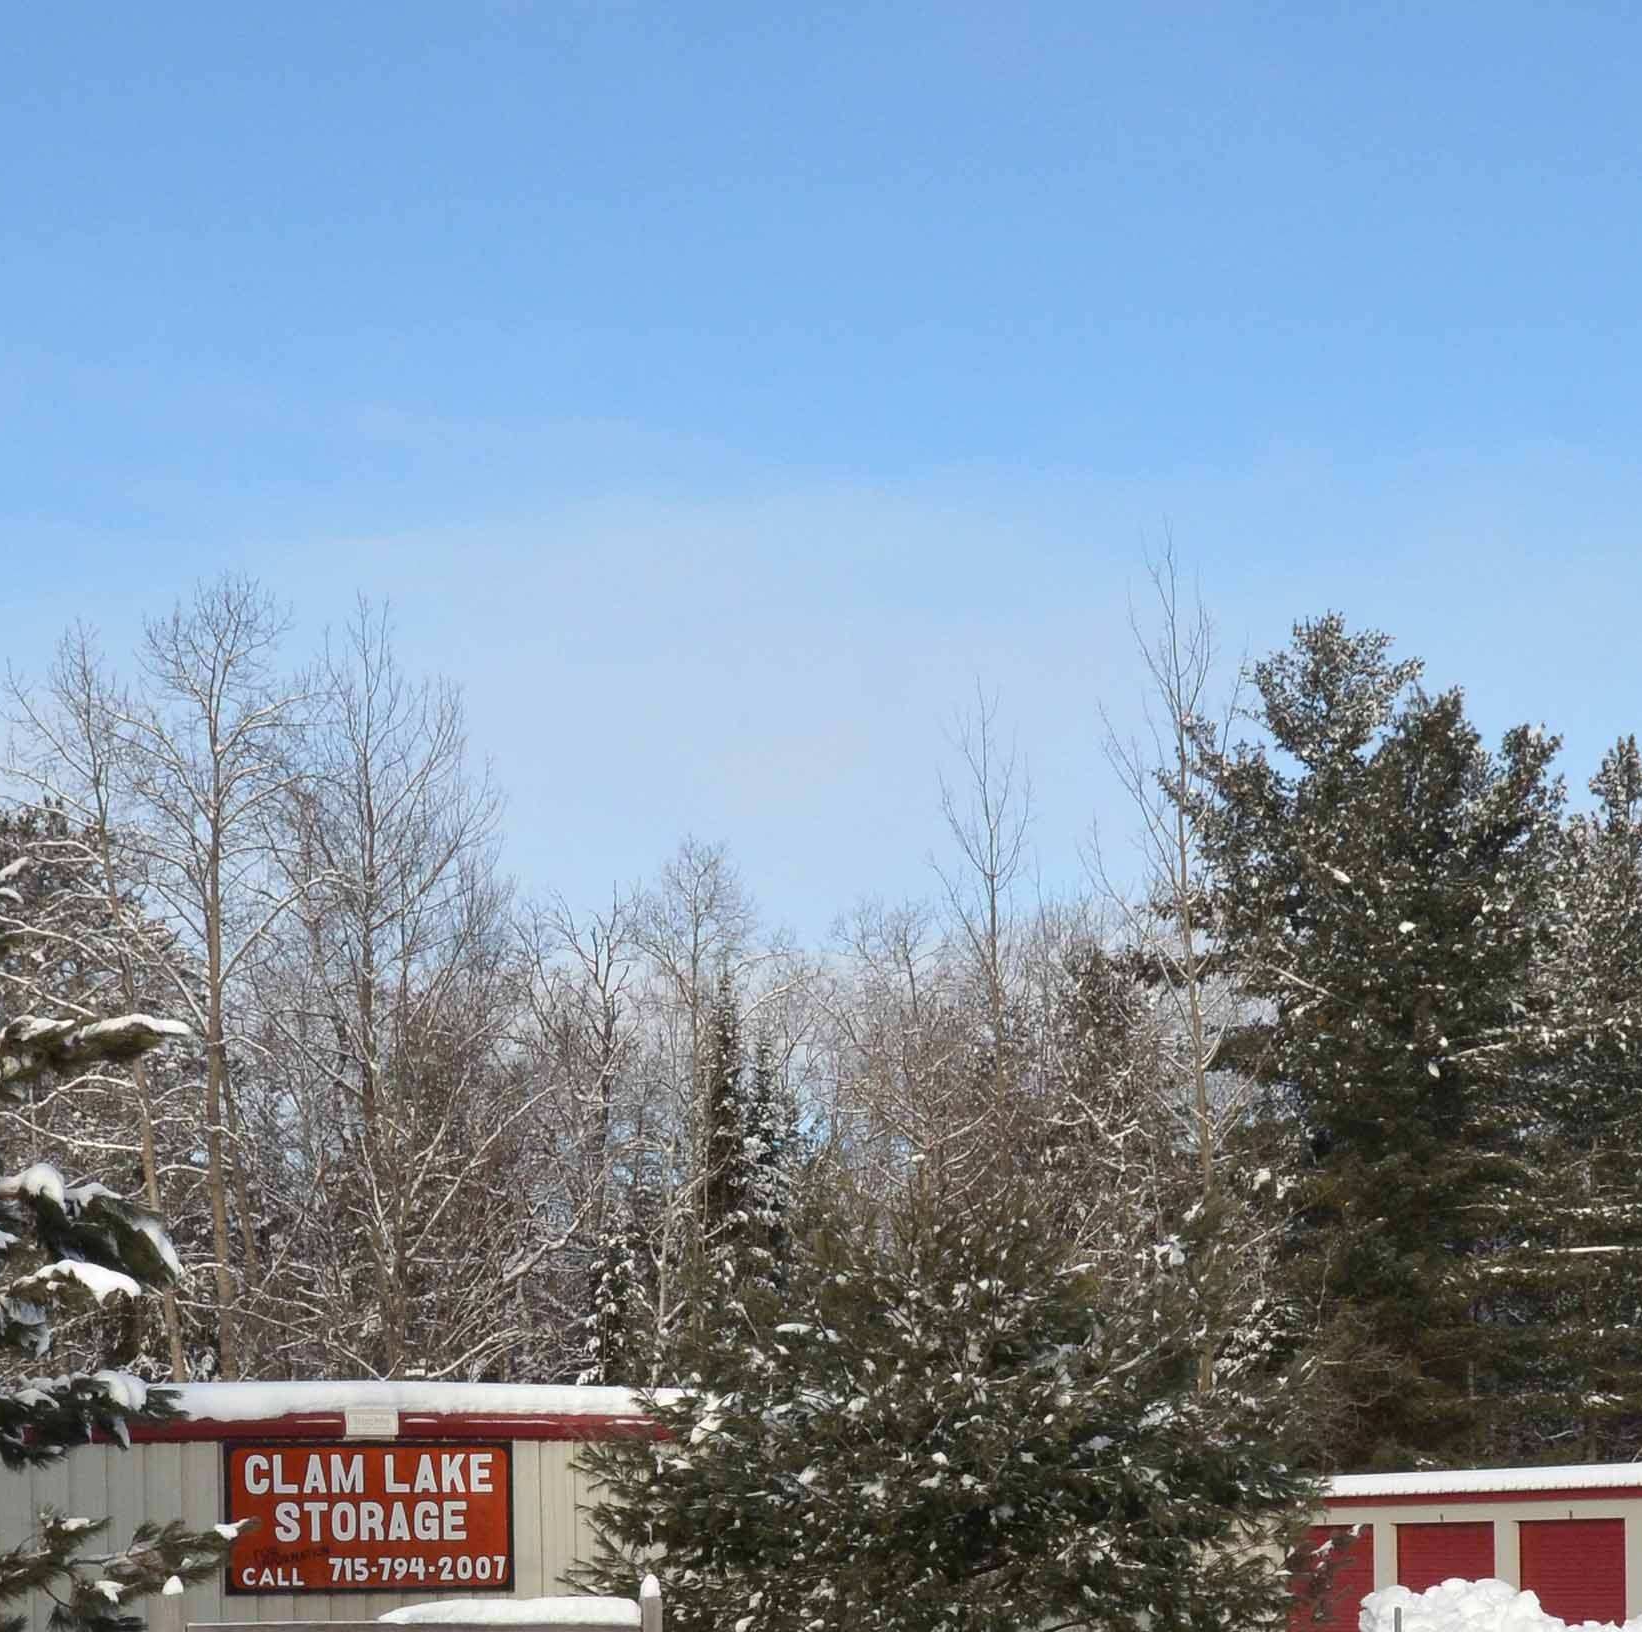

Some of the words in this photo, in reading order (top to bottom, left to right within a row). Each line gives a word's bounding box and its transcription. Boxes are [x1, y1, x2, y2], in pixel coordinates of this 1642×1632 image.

[244, 1454, 364, 1495] CLAM
[384, 1453, 494, 1493] LAKE
[275, 1500, 468, 1542] STORAGE
[242, 1567, 305, 1586] CALL
